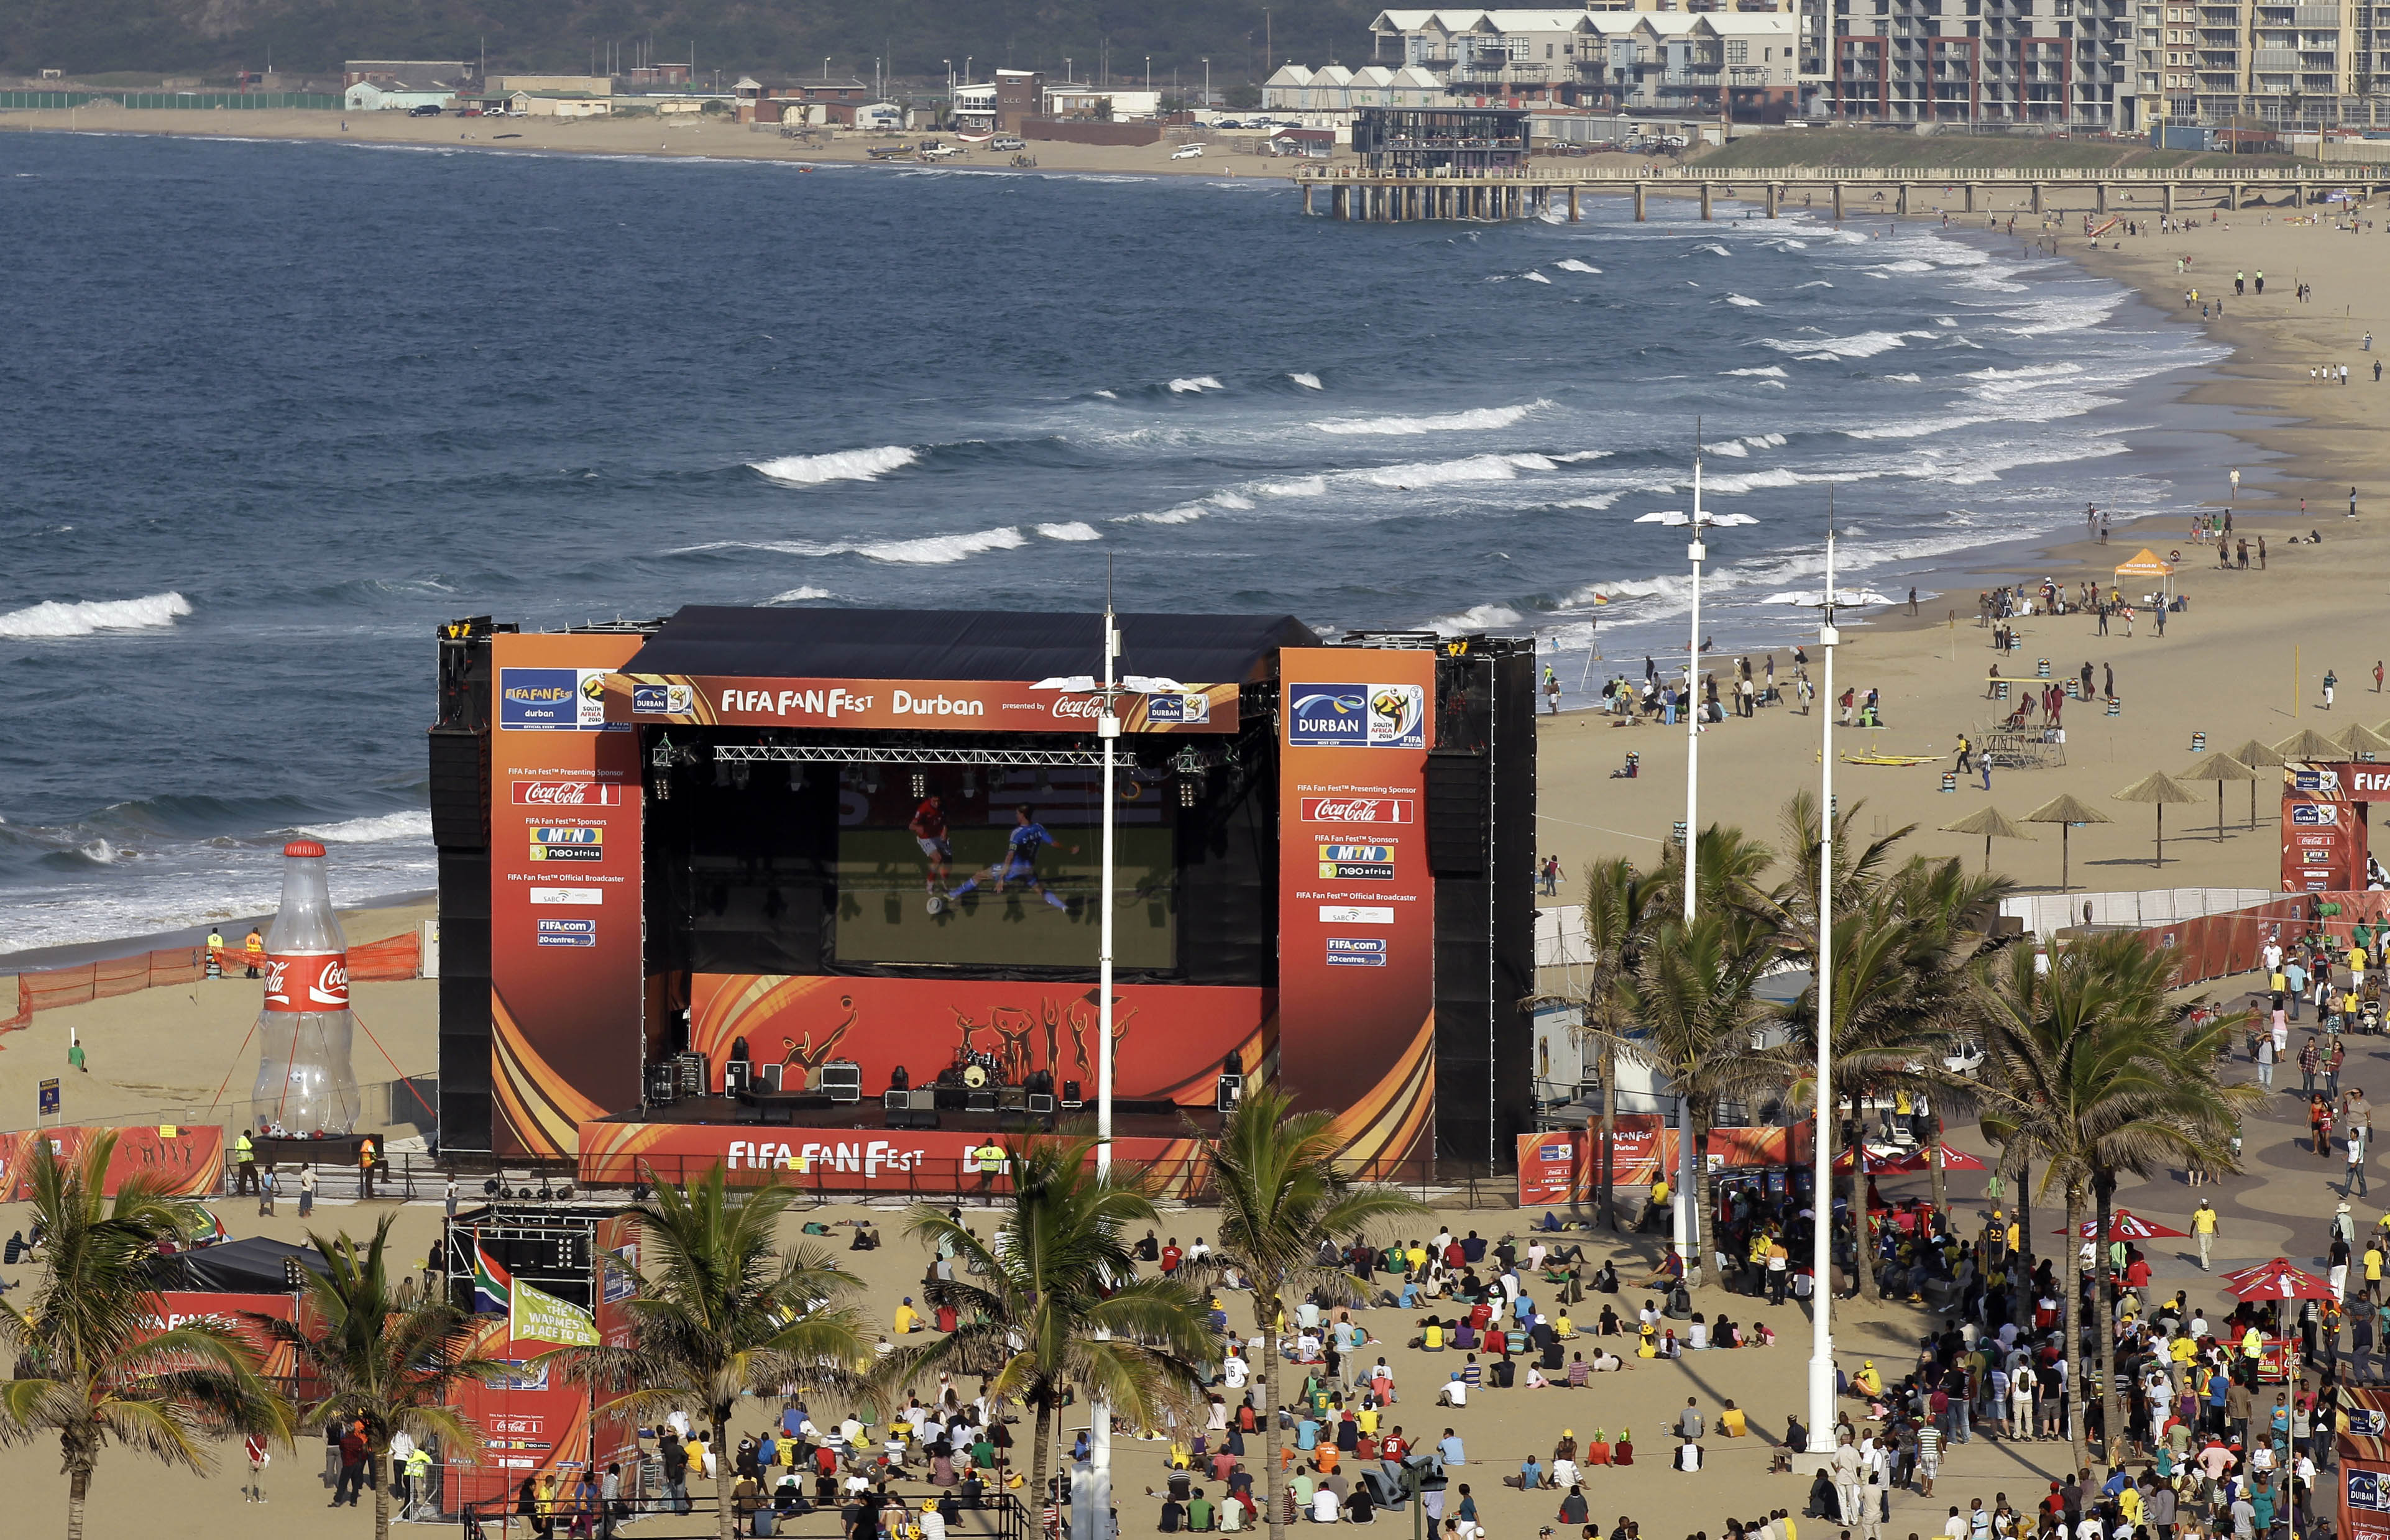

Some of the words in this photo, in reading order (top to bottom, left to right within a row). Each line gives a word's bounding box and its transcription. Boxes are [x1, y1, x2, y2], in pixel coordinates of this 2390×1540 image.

[505, 689, 529, 699] FIFA
[721, 689, 774, 712] FIFA
[777, 690, 824, 716] FAN
[827, 688, 874, 718] FEST
[893, 690, 984, 716] Durban
[1037, 703, 1045, 711] by
[1299, 719, 1359, 732] DURBAN
[560, 769, 595, 777] Presenting
[525, 782, 588, 804] Coca-Cola
[1351, 786, 1387, 794] Presenting
[1389, 786, 1416, 794] Sponsor
[1314, 799, 1379, 820] Coca-Cola
[548, 828, 585, 842] MTN
[1338, 846, 1376, 860] MTN
[1376, 893, 1417, 901] Broadcaster
[540, 921, 586, 930] FIFA.com
[1329, 940, 1377, 950] FIFA.com
[1599, 1132, 1618, 1140] FA
[1619, 1132, 1635, 1141] FAN
[727, 1141, 793, 1169] FIFA
[799, 1142, 860, 1173] FAN
[865, 1140, 924, 1178] FEST
[1394, 1252, 1402, 1262] 9
[546, 1305, 568, 1317] THE
[529, 1313, 586, 1331] WARMEST
[523, 1324, 558, 1337] PLACE
[560, 1329, 575, 1339] TO
[577, 1331, 591, 1343] BE
[1305, 1345, 1313, 1354] 10
[1228, 1366, 1235, 1377] 16
[1318, 1397, 1326, 1409] 9
[1387, 1441, 1397, 1452] 20
[2350, 1490, 2374, 1502] DURBAN
